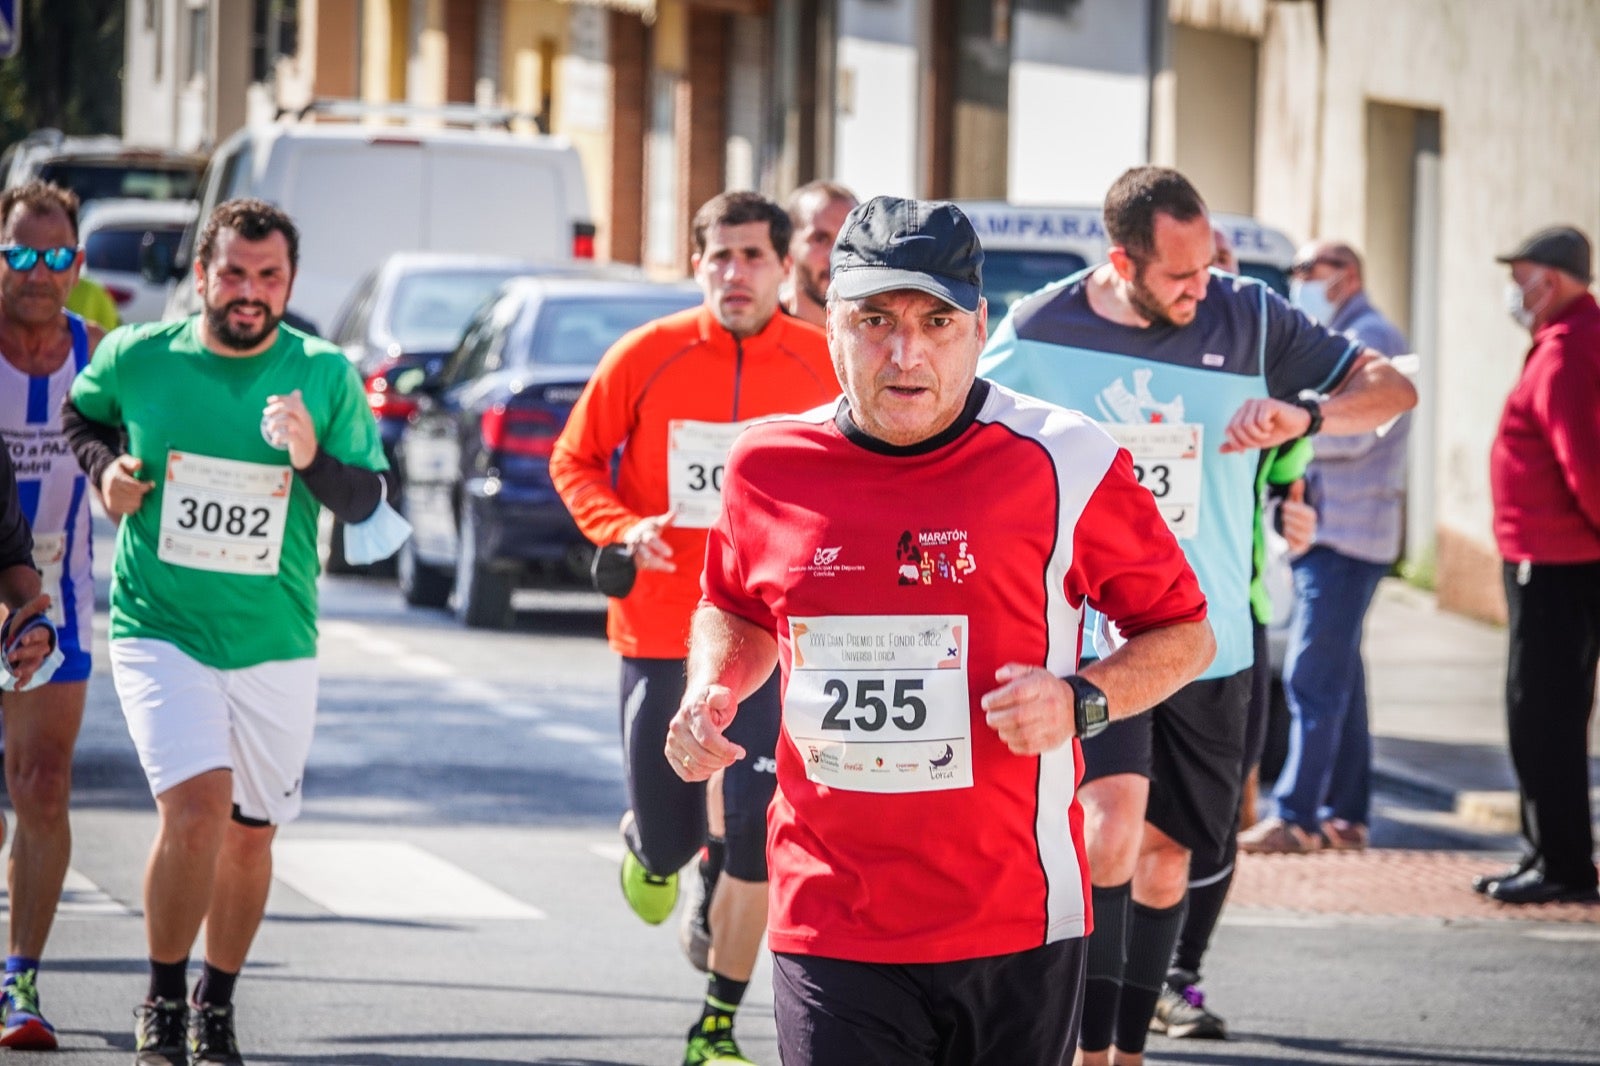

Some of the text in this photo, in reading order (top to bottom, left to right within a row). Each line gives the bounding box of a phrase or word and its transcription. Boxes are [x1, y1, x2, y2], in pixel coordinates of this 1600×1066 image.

[177, 498, 270, 537] 3082
[919, 529, 968, 543] MARATÓN
[918, 631, 942, 647] 2022
[821, 678, 927, 732] 255
